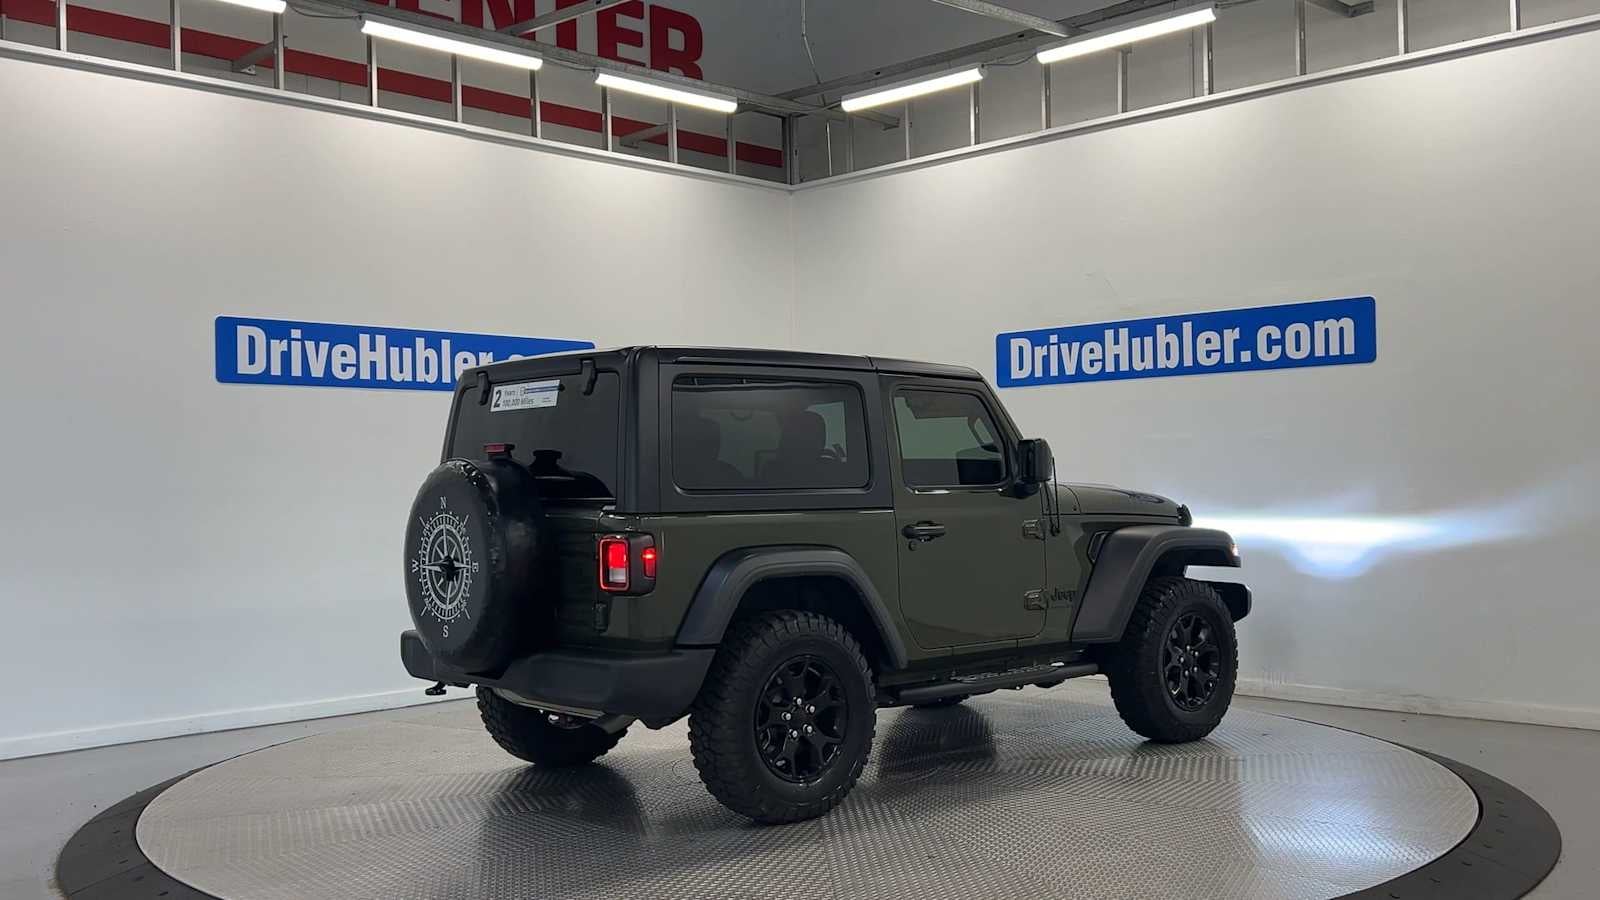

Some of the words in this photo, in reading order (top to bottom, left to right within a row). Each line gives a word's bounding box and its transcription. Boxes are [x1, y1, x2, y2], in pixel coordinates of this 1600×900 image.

[372, 0, 703, 81] NTER
[236, 325, 545, 385] DriveHubler
[1009, 317, 1355, 380] DriveHubler.com
[493, 389, 502, 408] 2
[440, 496, 447, 509] N
[411, 559, 420, 573] W
[442, 625, 449, 638] S
